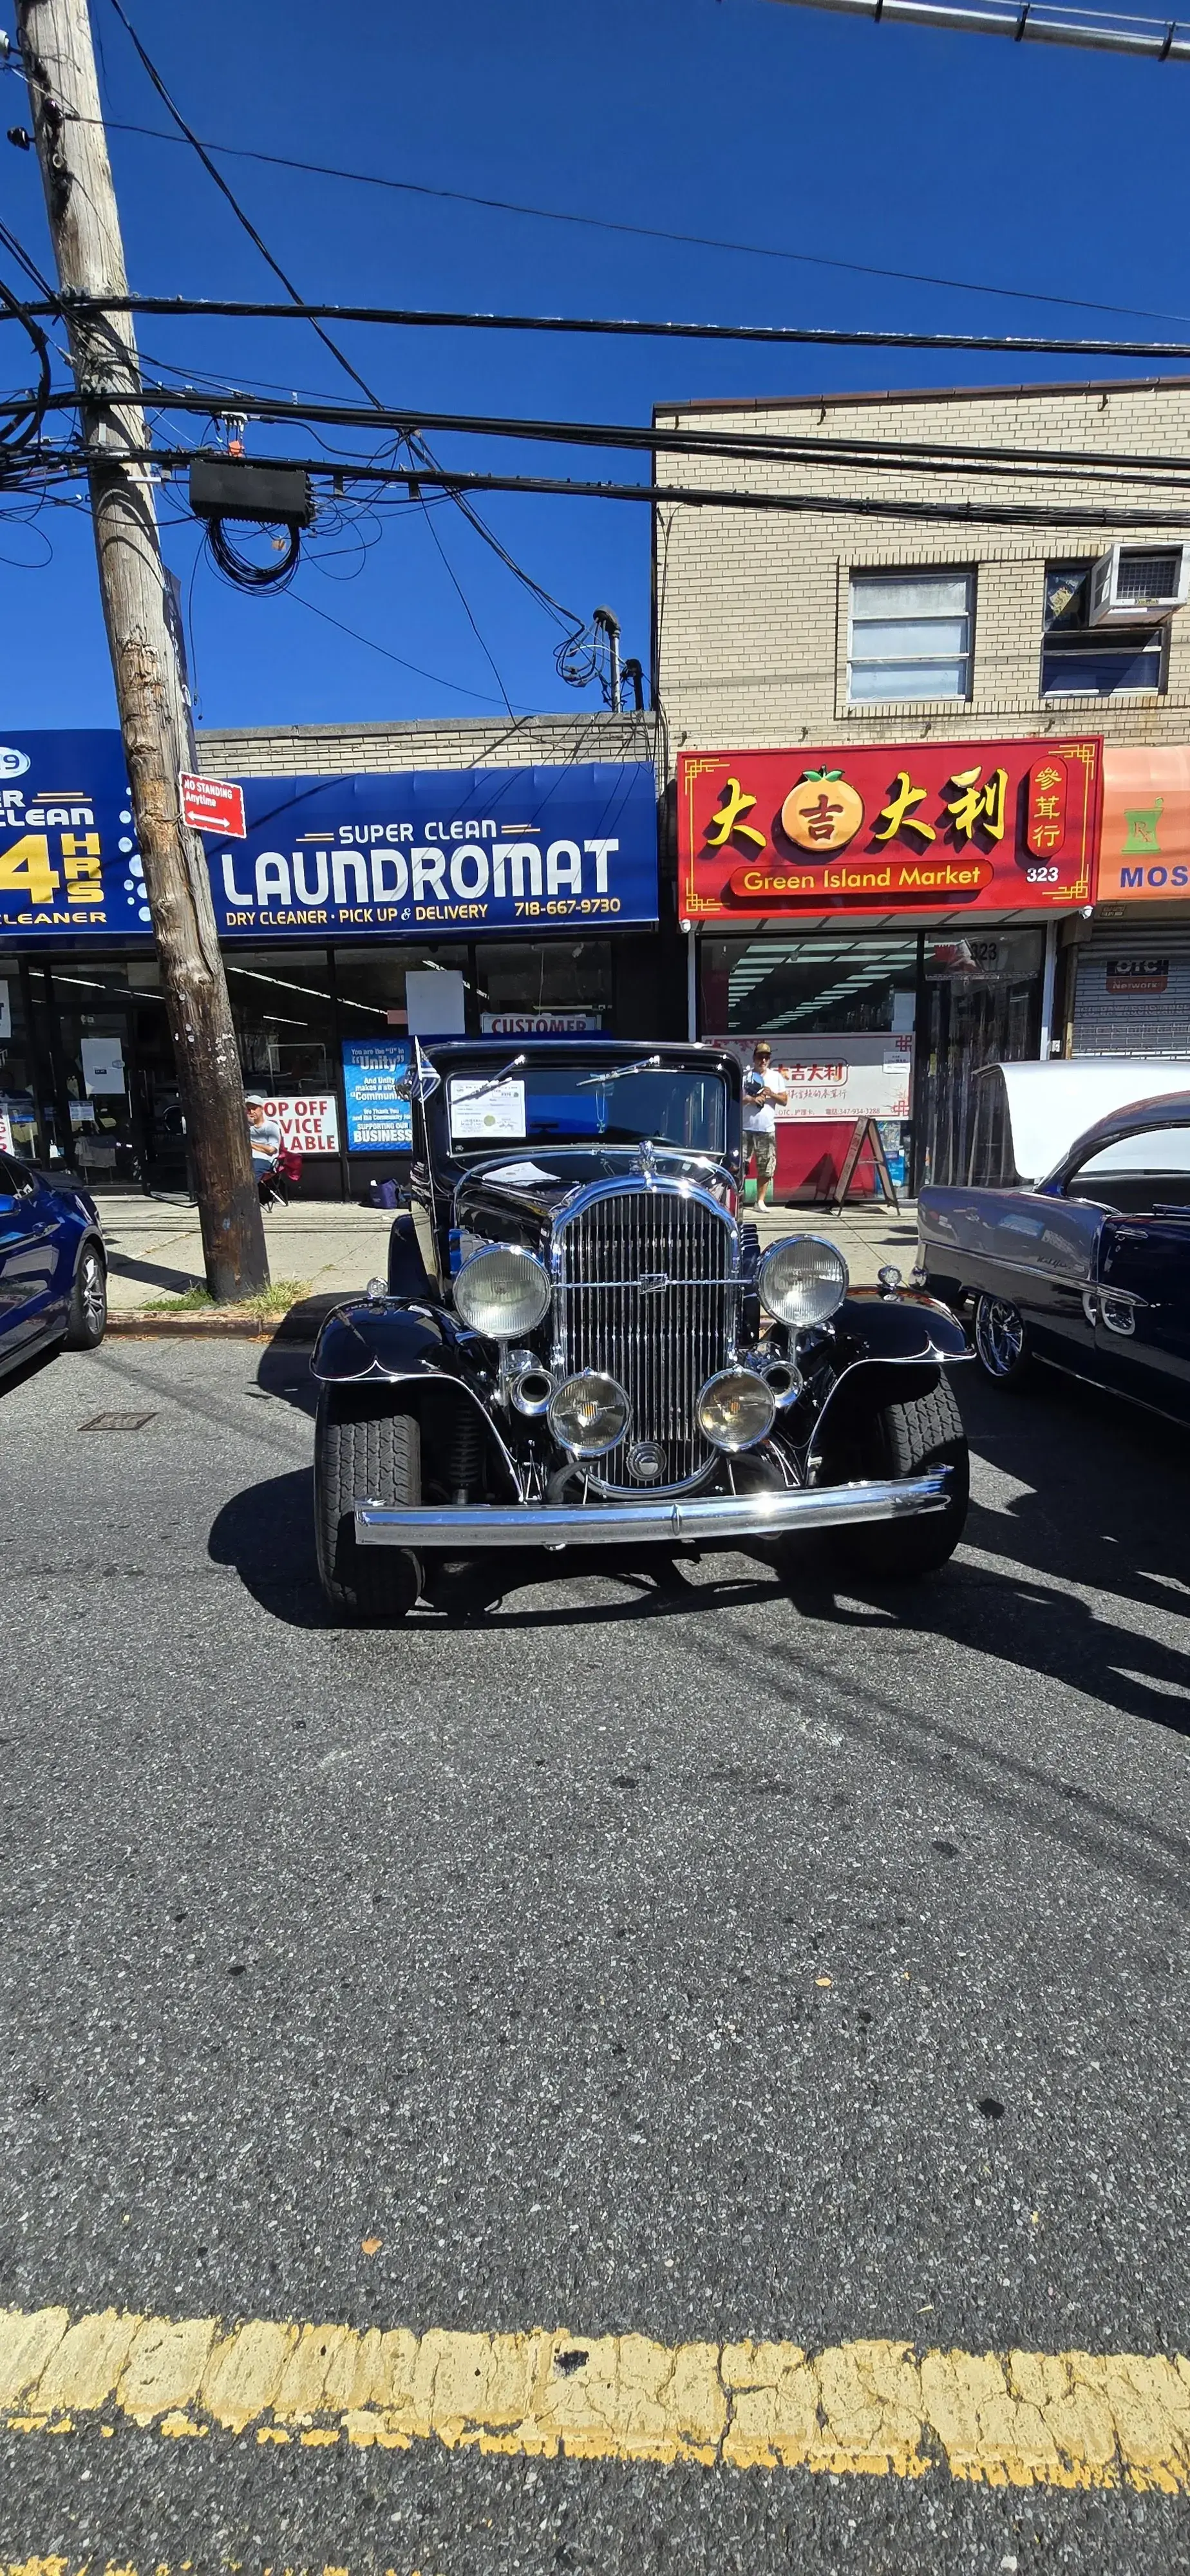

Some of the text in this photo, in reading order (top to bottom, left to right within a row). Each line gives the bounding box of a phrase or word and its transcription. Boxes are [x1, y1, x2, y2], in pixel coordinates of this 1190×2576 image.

[184, 779, 232, 800] NO STANDING
[185, 791, 216, 807] Anytime
[339, 819, 497, 844] SUPER CLEAN
[222, 838, 619, 906] LAUNDROMAT
[744, 864, 981, 890] Green Island Market
[1026, 866, 1059, 883] 323
[0, 912, 107, 925] LEANER
[227, 898, 621, 926] DRY CLEANER PICK UP & DELIVERY 718-667-9730
[491, 1018, 587, 1033] CUSTOMER
[377, 1076, 395, 1084] Unity
[264, 1101, 327, 1117] OP OFF
[278, 1118, 322, 1133] VICE
[354, 1129, 412, 1142] BUSINESS
